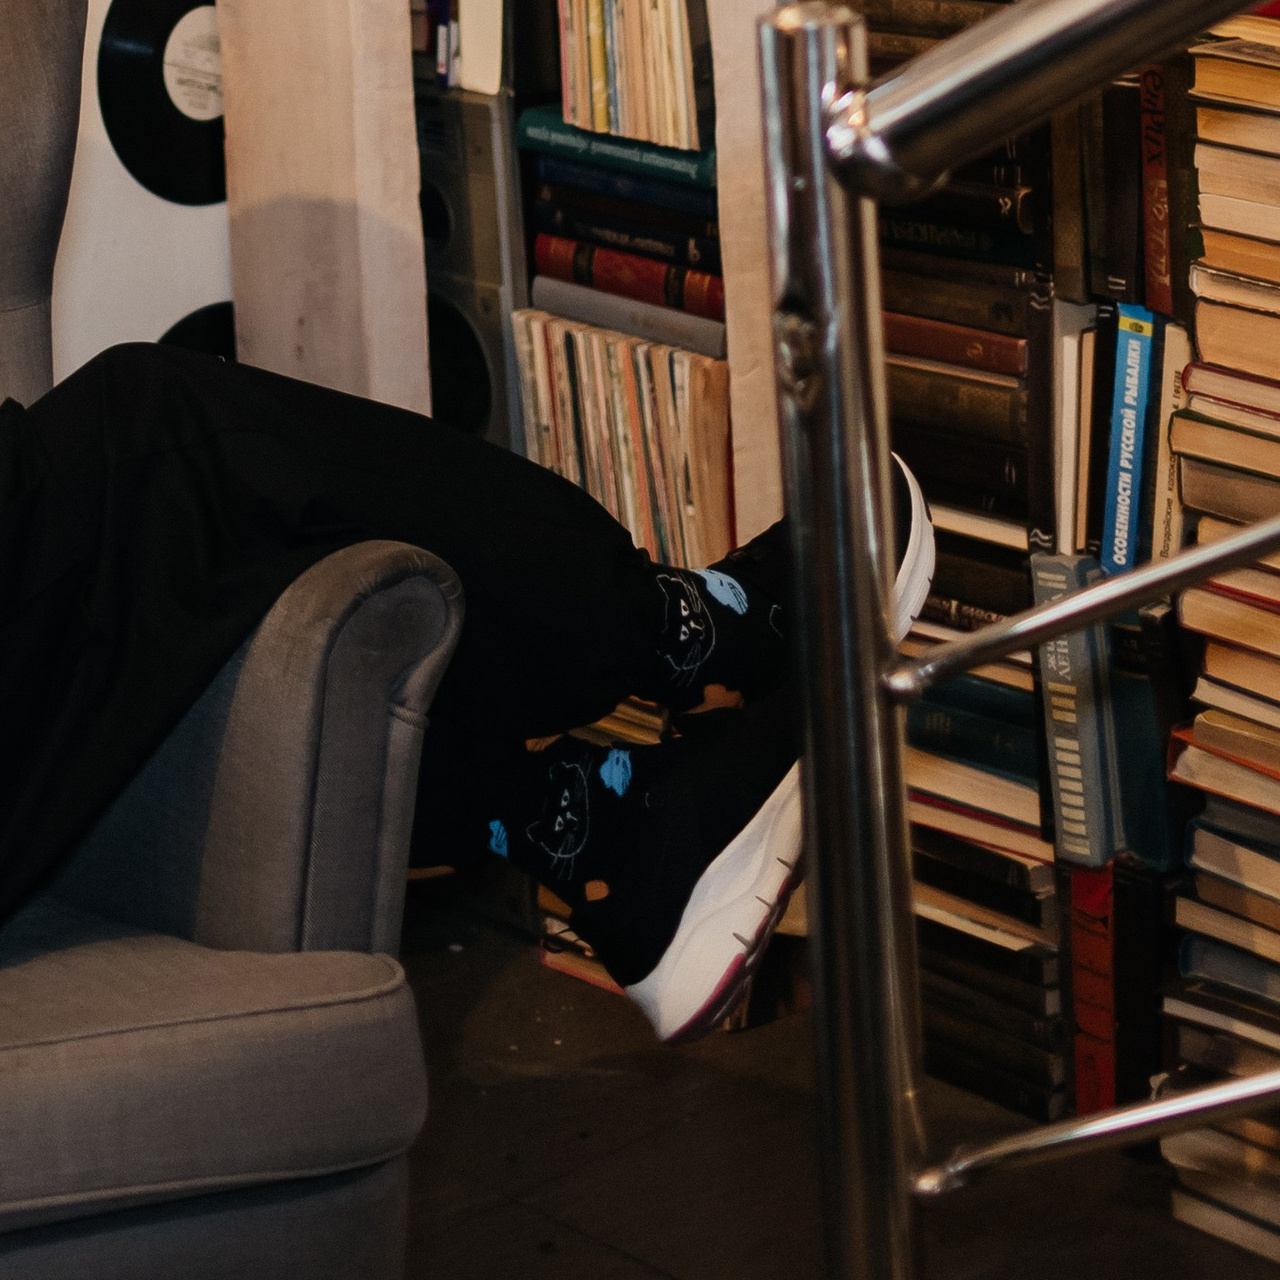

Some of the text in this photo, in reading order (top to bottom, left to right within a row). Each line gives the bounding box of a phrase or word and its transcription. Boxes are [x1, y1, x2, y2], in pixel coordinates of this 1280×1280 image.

[1113, 339, 1141, 565] ОСОБЕННОСТИ РУССКОЙ РЫБАЛКИ
[1160, 498, 1174, 559] Валдайские
